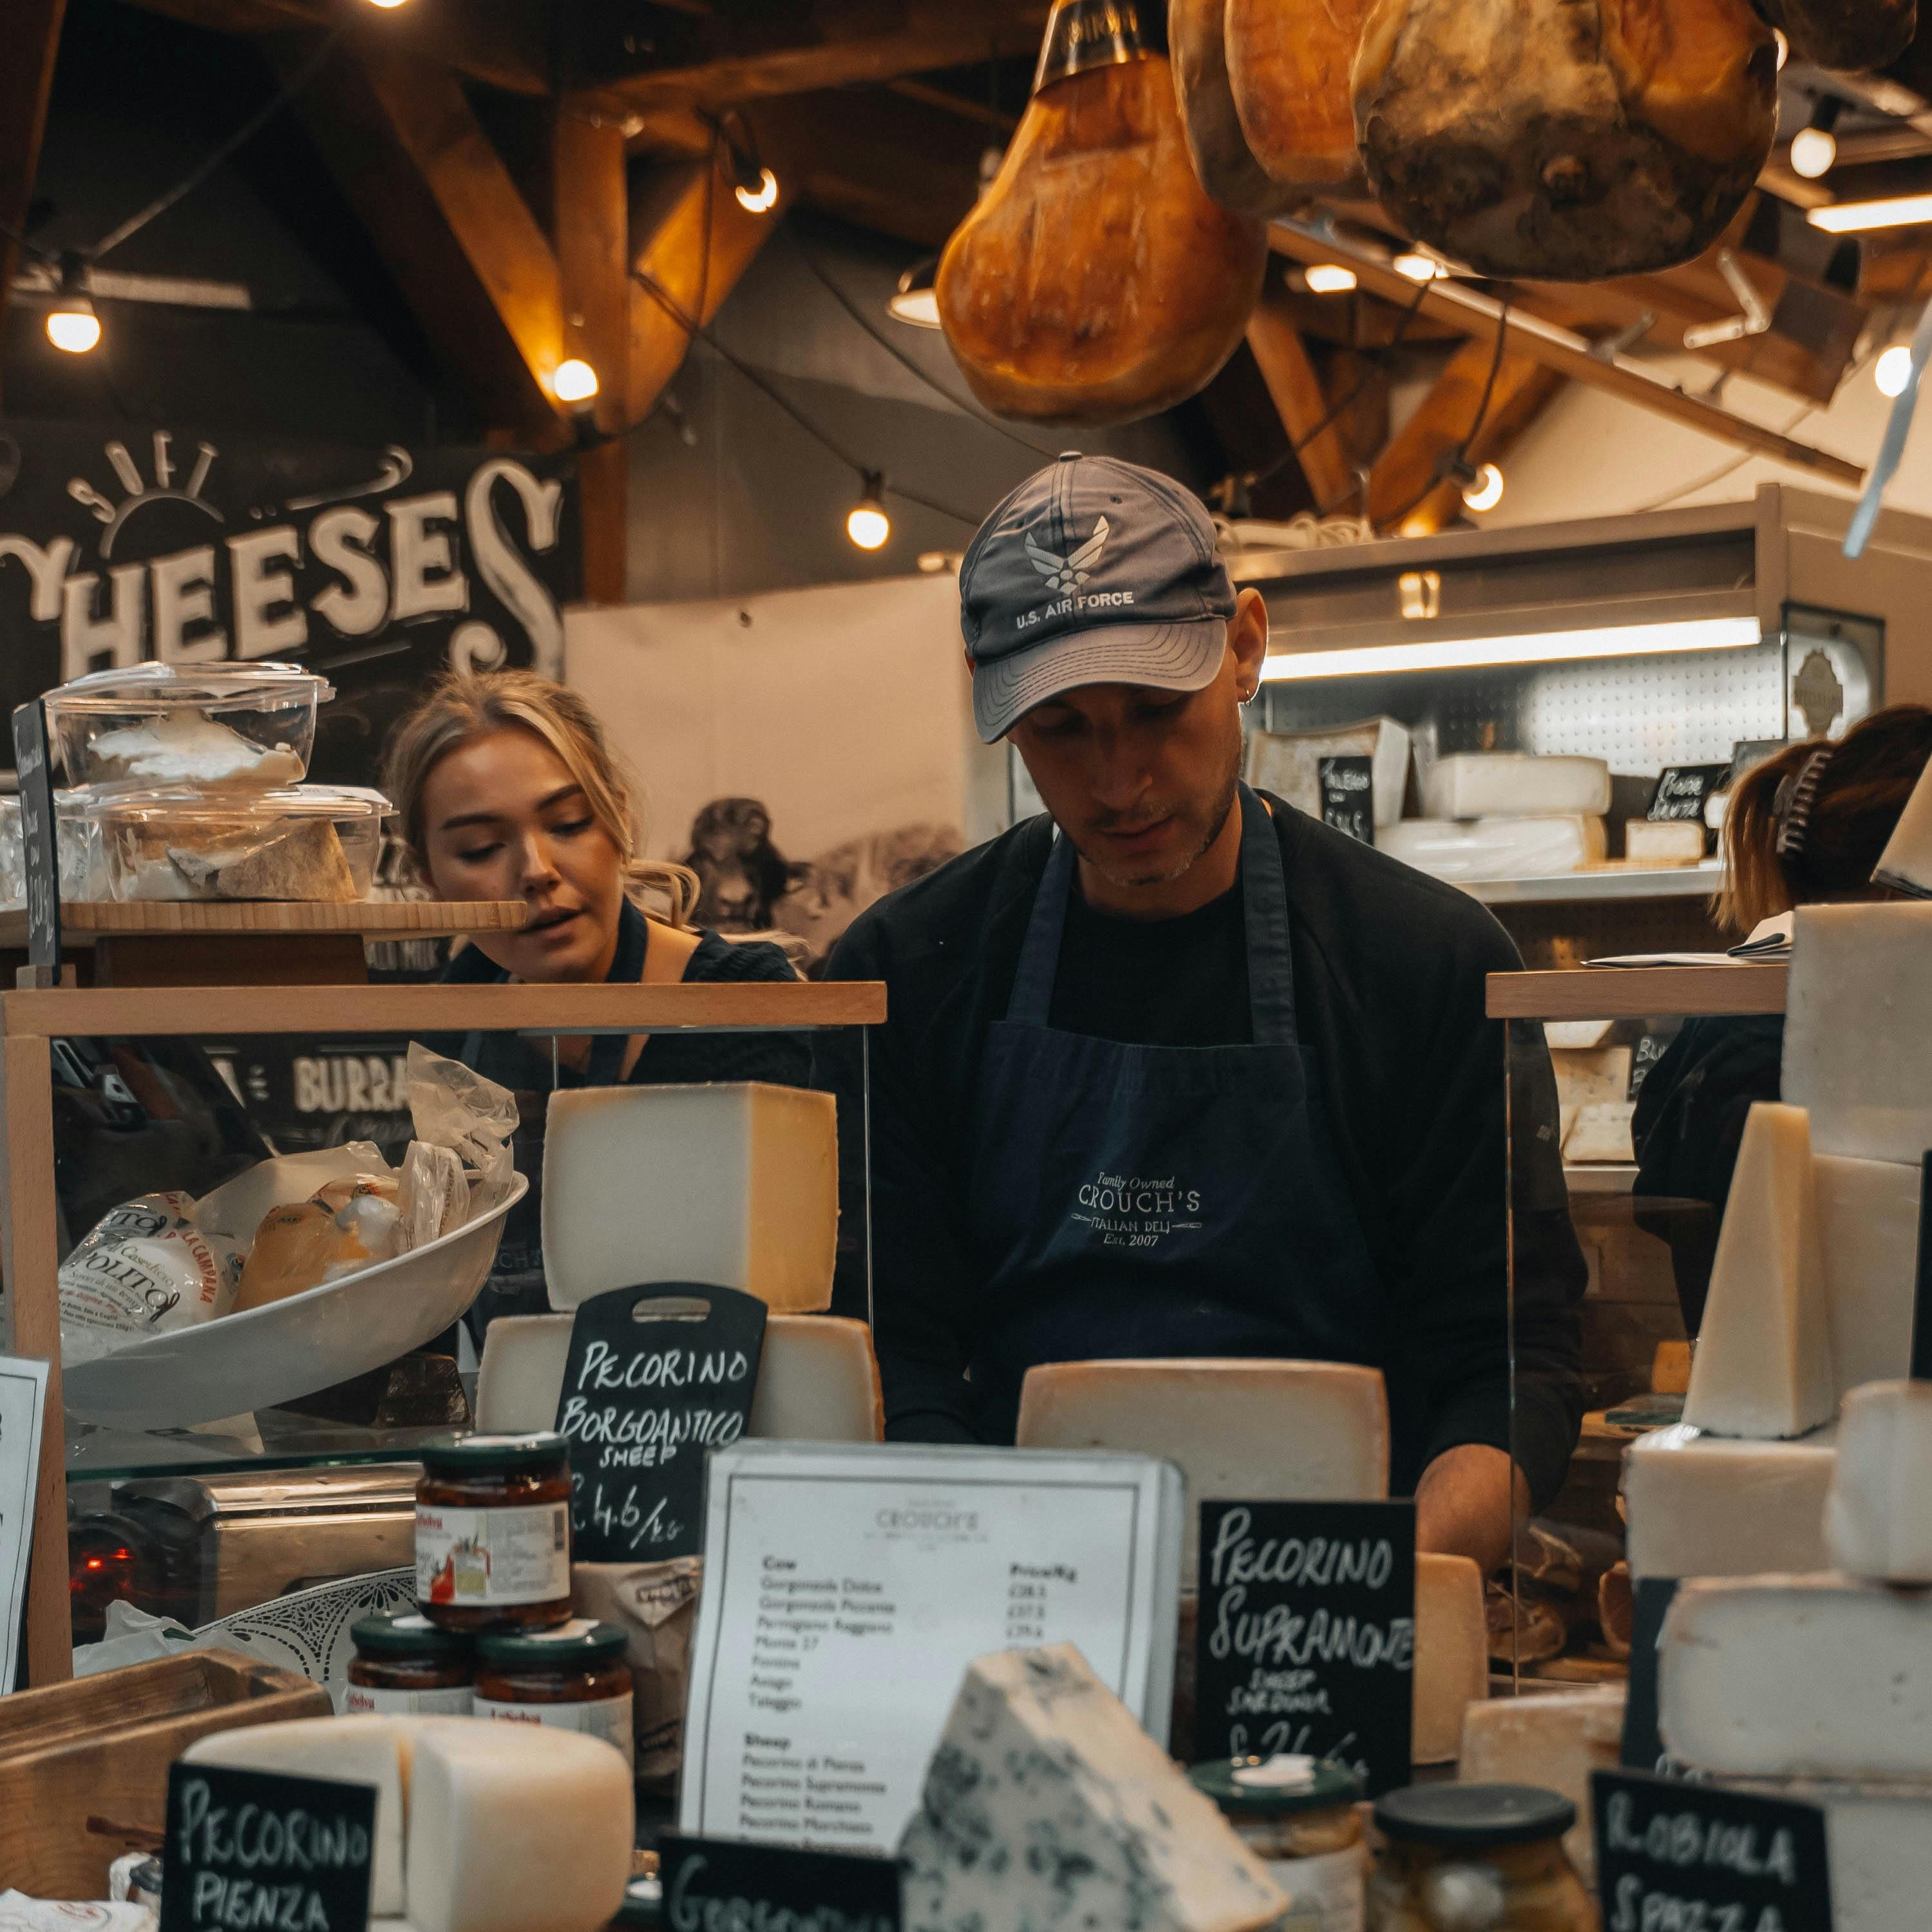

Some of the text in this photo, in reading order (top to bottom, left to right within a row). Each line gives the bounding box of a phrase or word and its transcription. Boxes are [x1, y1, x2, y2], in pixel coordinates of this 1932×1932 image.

[1016, 591, 1135, 630] U.S. AIR FORCE
[1079, 1184, 1201, 1213] CROUCH'S
[1097, 1171, 1175, 1190] Family Owned
[1091, 1217, 1171, 1234] ITALIAN DELI
[1103, 1233, 1159, 1247] Est. 2007
[578, 1340, 748, 1391] PECORINO
[559, 1395, 744, 1446] BORGOANTICO
[598, 1444, 677, 1468] SHEEP
[1210, 1506, 1393, 1590] PECORINO
[180, 1778, 368, 1871] PECORINO
[194, 1870, 330, 1932] PIENZA
